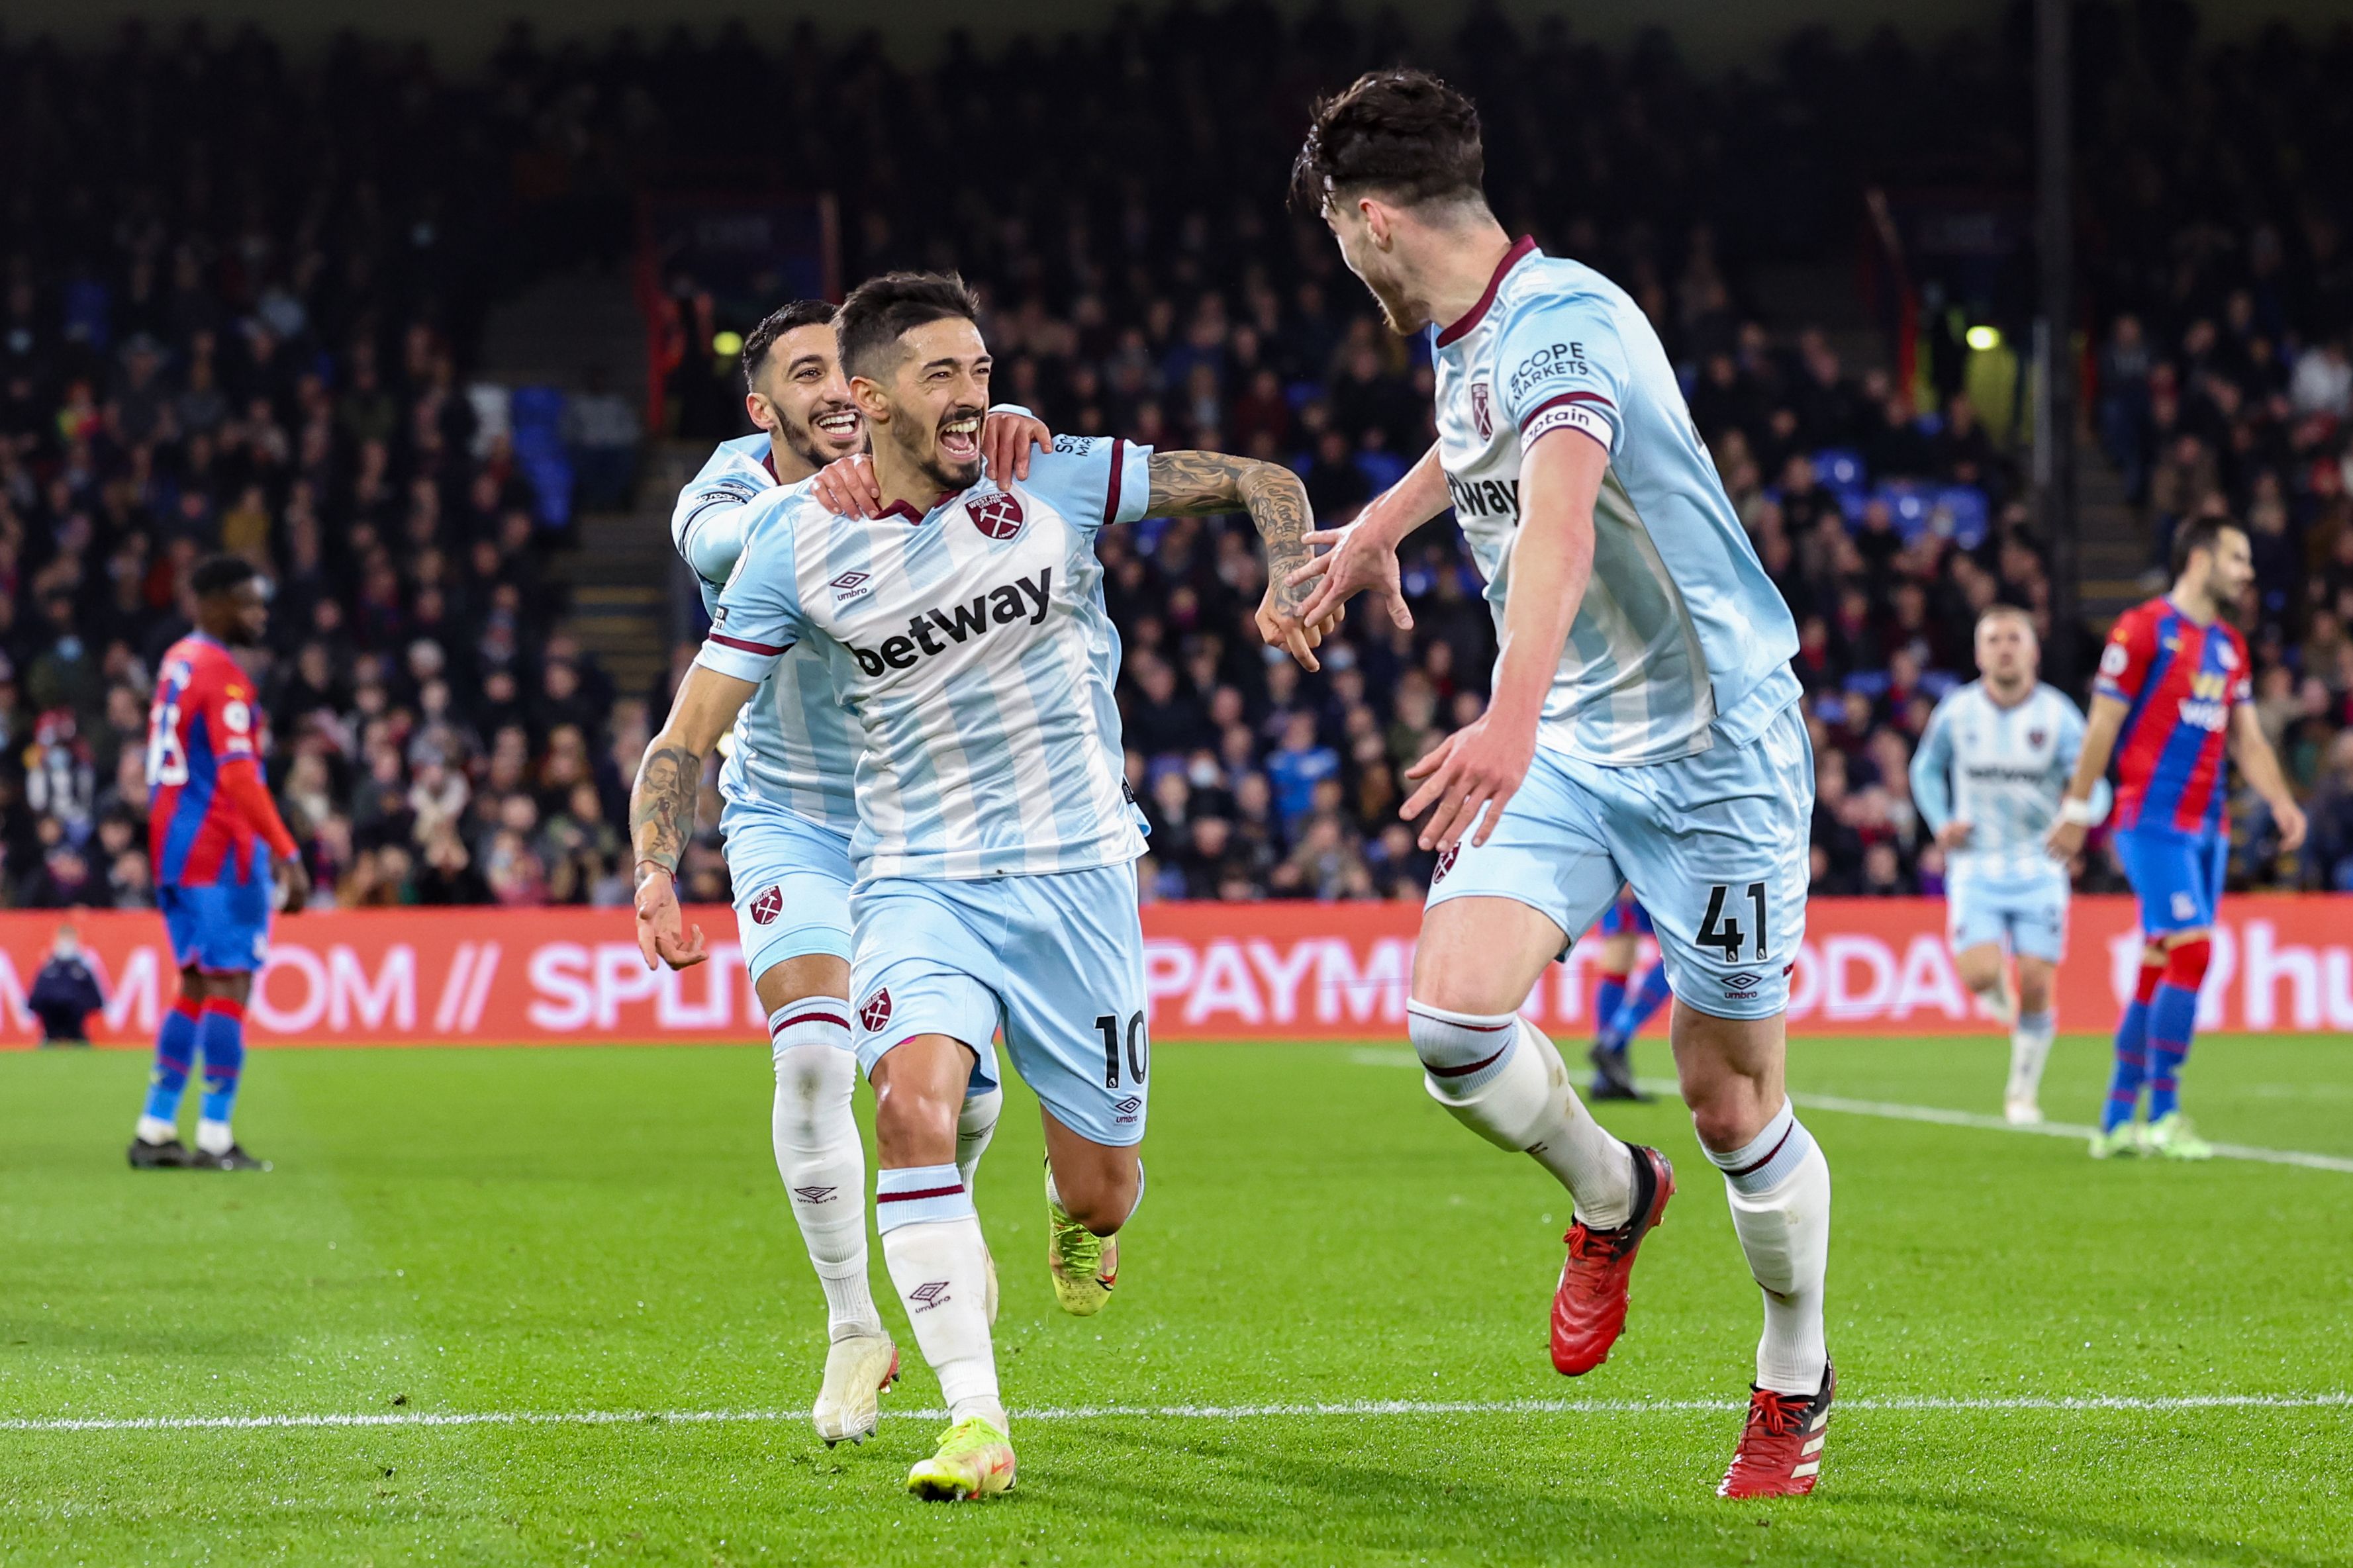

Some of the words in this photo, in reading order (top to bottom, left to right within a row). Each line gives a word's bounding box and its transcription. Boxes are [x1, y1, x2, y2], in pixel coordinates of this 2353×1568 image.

[1511, 342, 1585, 389] SCOPE
[968, 496, 988, 509] WEST
[989, 492, 1008, 502] HAM
[837, 586, 867, 602] umbro
[845, 567, 1052, 677] betway
[1695, 882, 1768, 962] 41
[1725, 991, 1758, 1000] umbro
[1094, 1009, 1147, 1089] 10
[1116, 1114, 1138, 1124] umbro
[796, 1195, 838, 1204] umbro
[915, 1295, 951, 1314] umbro
